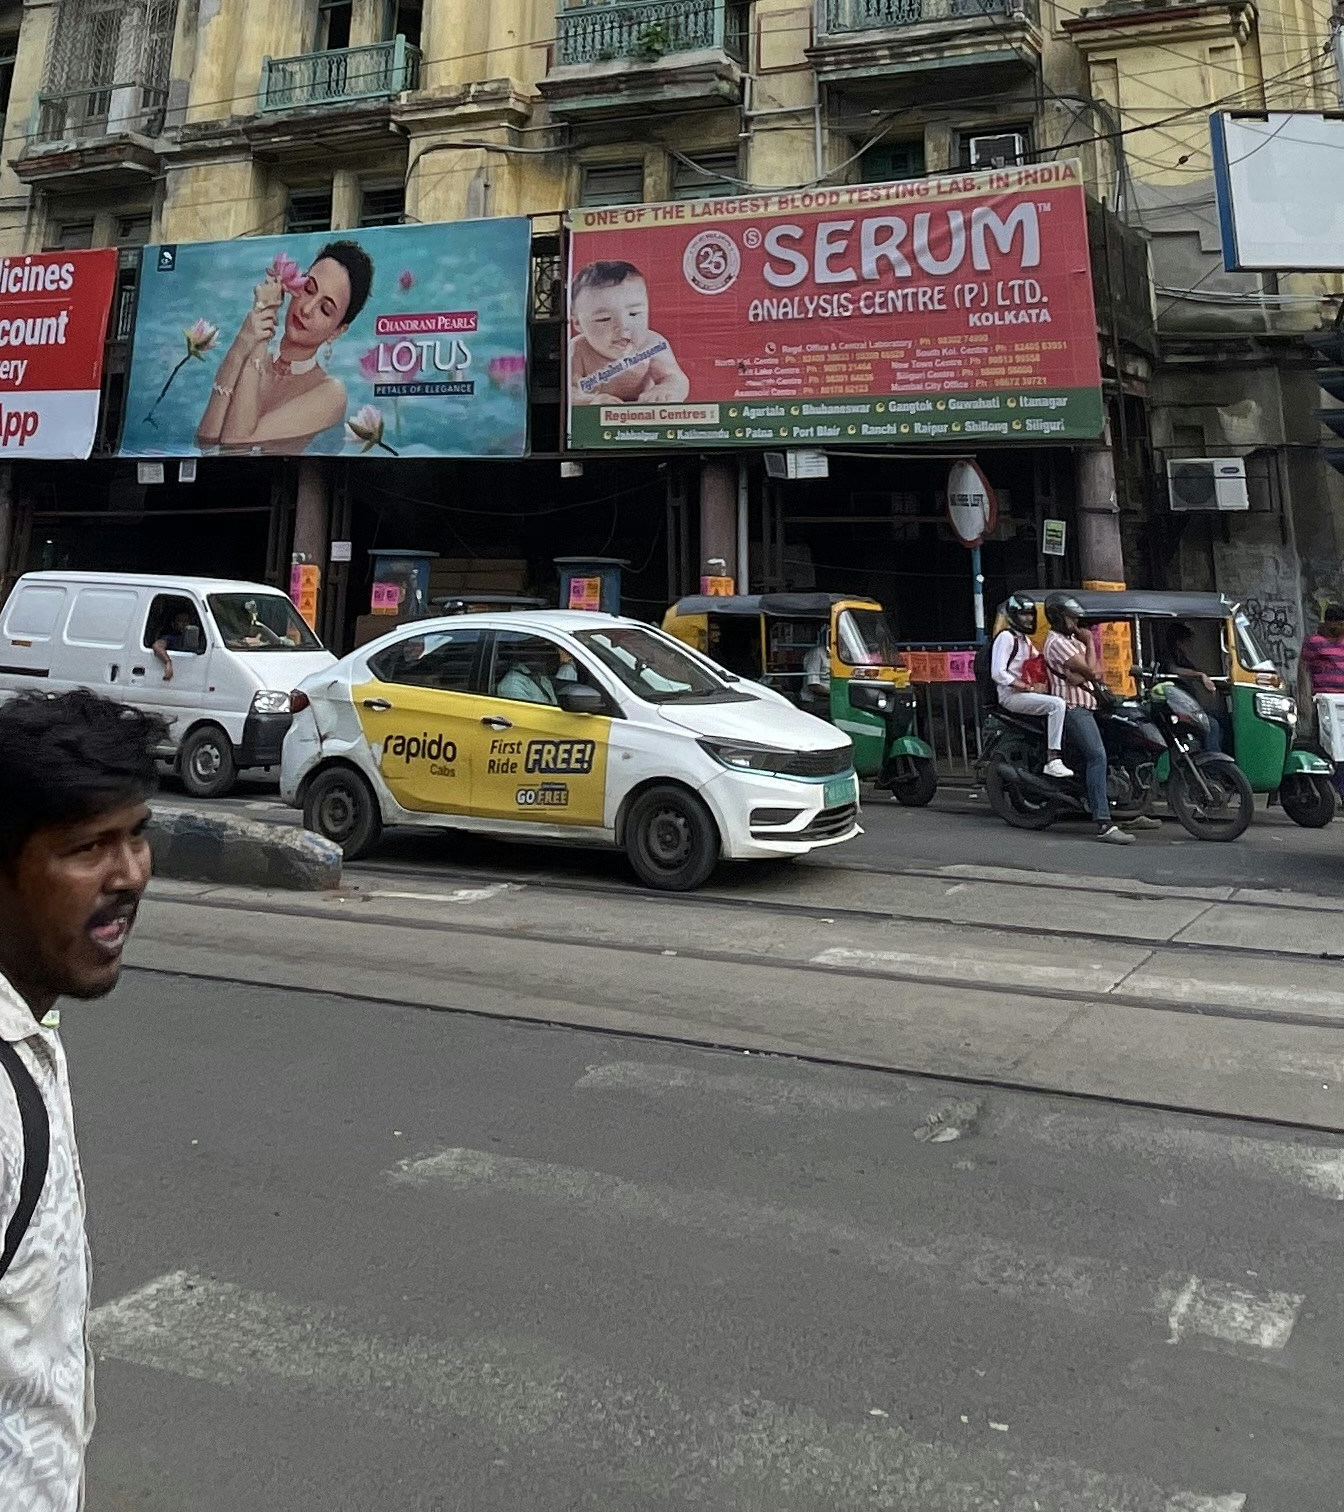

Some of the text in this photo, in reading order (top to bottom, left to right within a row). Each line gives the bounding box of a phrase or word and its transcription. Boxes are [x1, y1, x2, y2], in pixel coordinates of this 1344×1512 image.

[584, 164, 1077, 226] ONE OF THE LARGEST BLOOD TESTING LAB. IN INDIA
[764, 202, 1040, 288] SERUM
[698, 246, 726, 274] 25
[748, 279, 1050, 322] ANALYSIS CENTRE (P) LTD.
[378, 316, 475, 333] CHANDRANI PEARLS
[968, 308, 1052, 327] KOLKATA
[377, 339, 472, 372] LOTUS
[377, 383, 472, 395] PETALS OF ELEGANCE
[802, 403, 871, 415] Bhubaneswar
[888, 399, 933, 414] Gangtok
[948, 396, 1000, 410] Guwahati
[1019, 395, 1068, 409] Itanagar
[605, 409, 707, 423] Regional Centres
[742, 406, 785, 419] Agartala
[745, 427, 773, 438] Patna
[792, 424, 841, 437] Port Blair
[861, 423, 897, 435] Ranchi
[914, 421, 949, 436] Raipur
[965, 420, 1008, 434] Shillong
[1025, 418, 1065, 433] Siliguri
[383, 732, 457, 763] rapido
[490, 739, 522, 755] First
[527, 744, 593, 770] FREE!
[430, 764, 456, 777] Cabs
[488, 759, 518, 774] Ride
[517, 790, 568, 805] GO FREE
